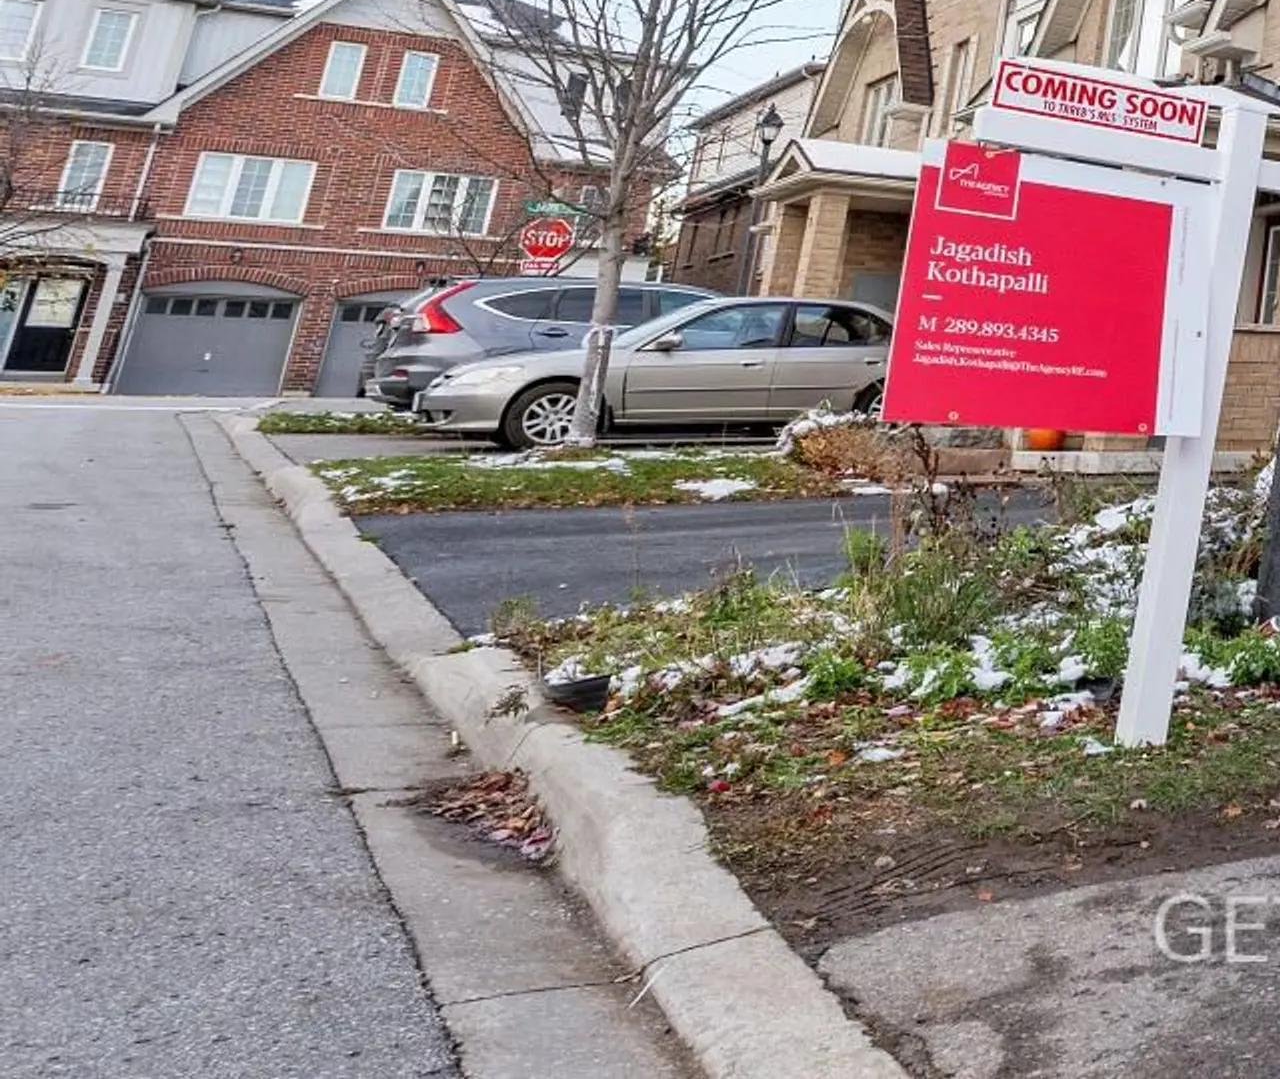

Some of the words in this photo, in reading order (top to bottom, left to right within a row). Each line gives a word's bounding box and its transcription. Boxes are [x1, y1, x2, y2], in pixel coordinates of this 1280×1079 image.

[1005, 70, 1117, 110] COMING
[1125, 93, 1198, 127] SOON
[523, 229, 570, 249] STOP
[930, 234, 1032, 267] Jagadish
[926, 260, 1049, 294] Kothapalli
[917, 315, 938, 333] M
[943, 317, 1060, 343] 289.893.4345
[914, 339, 942, 351] Sales
